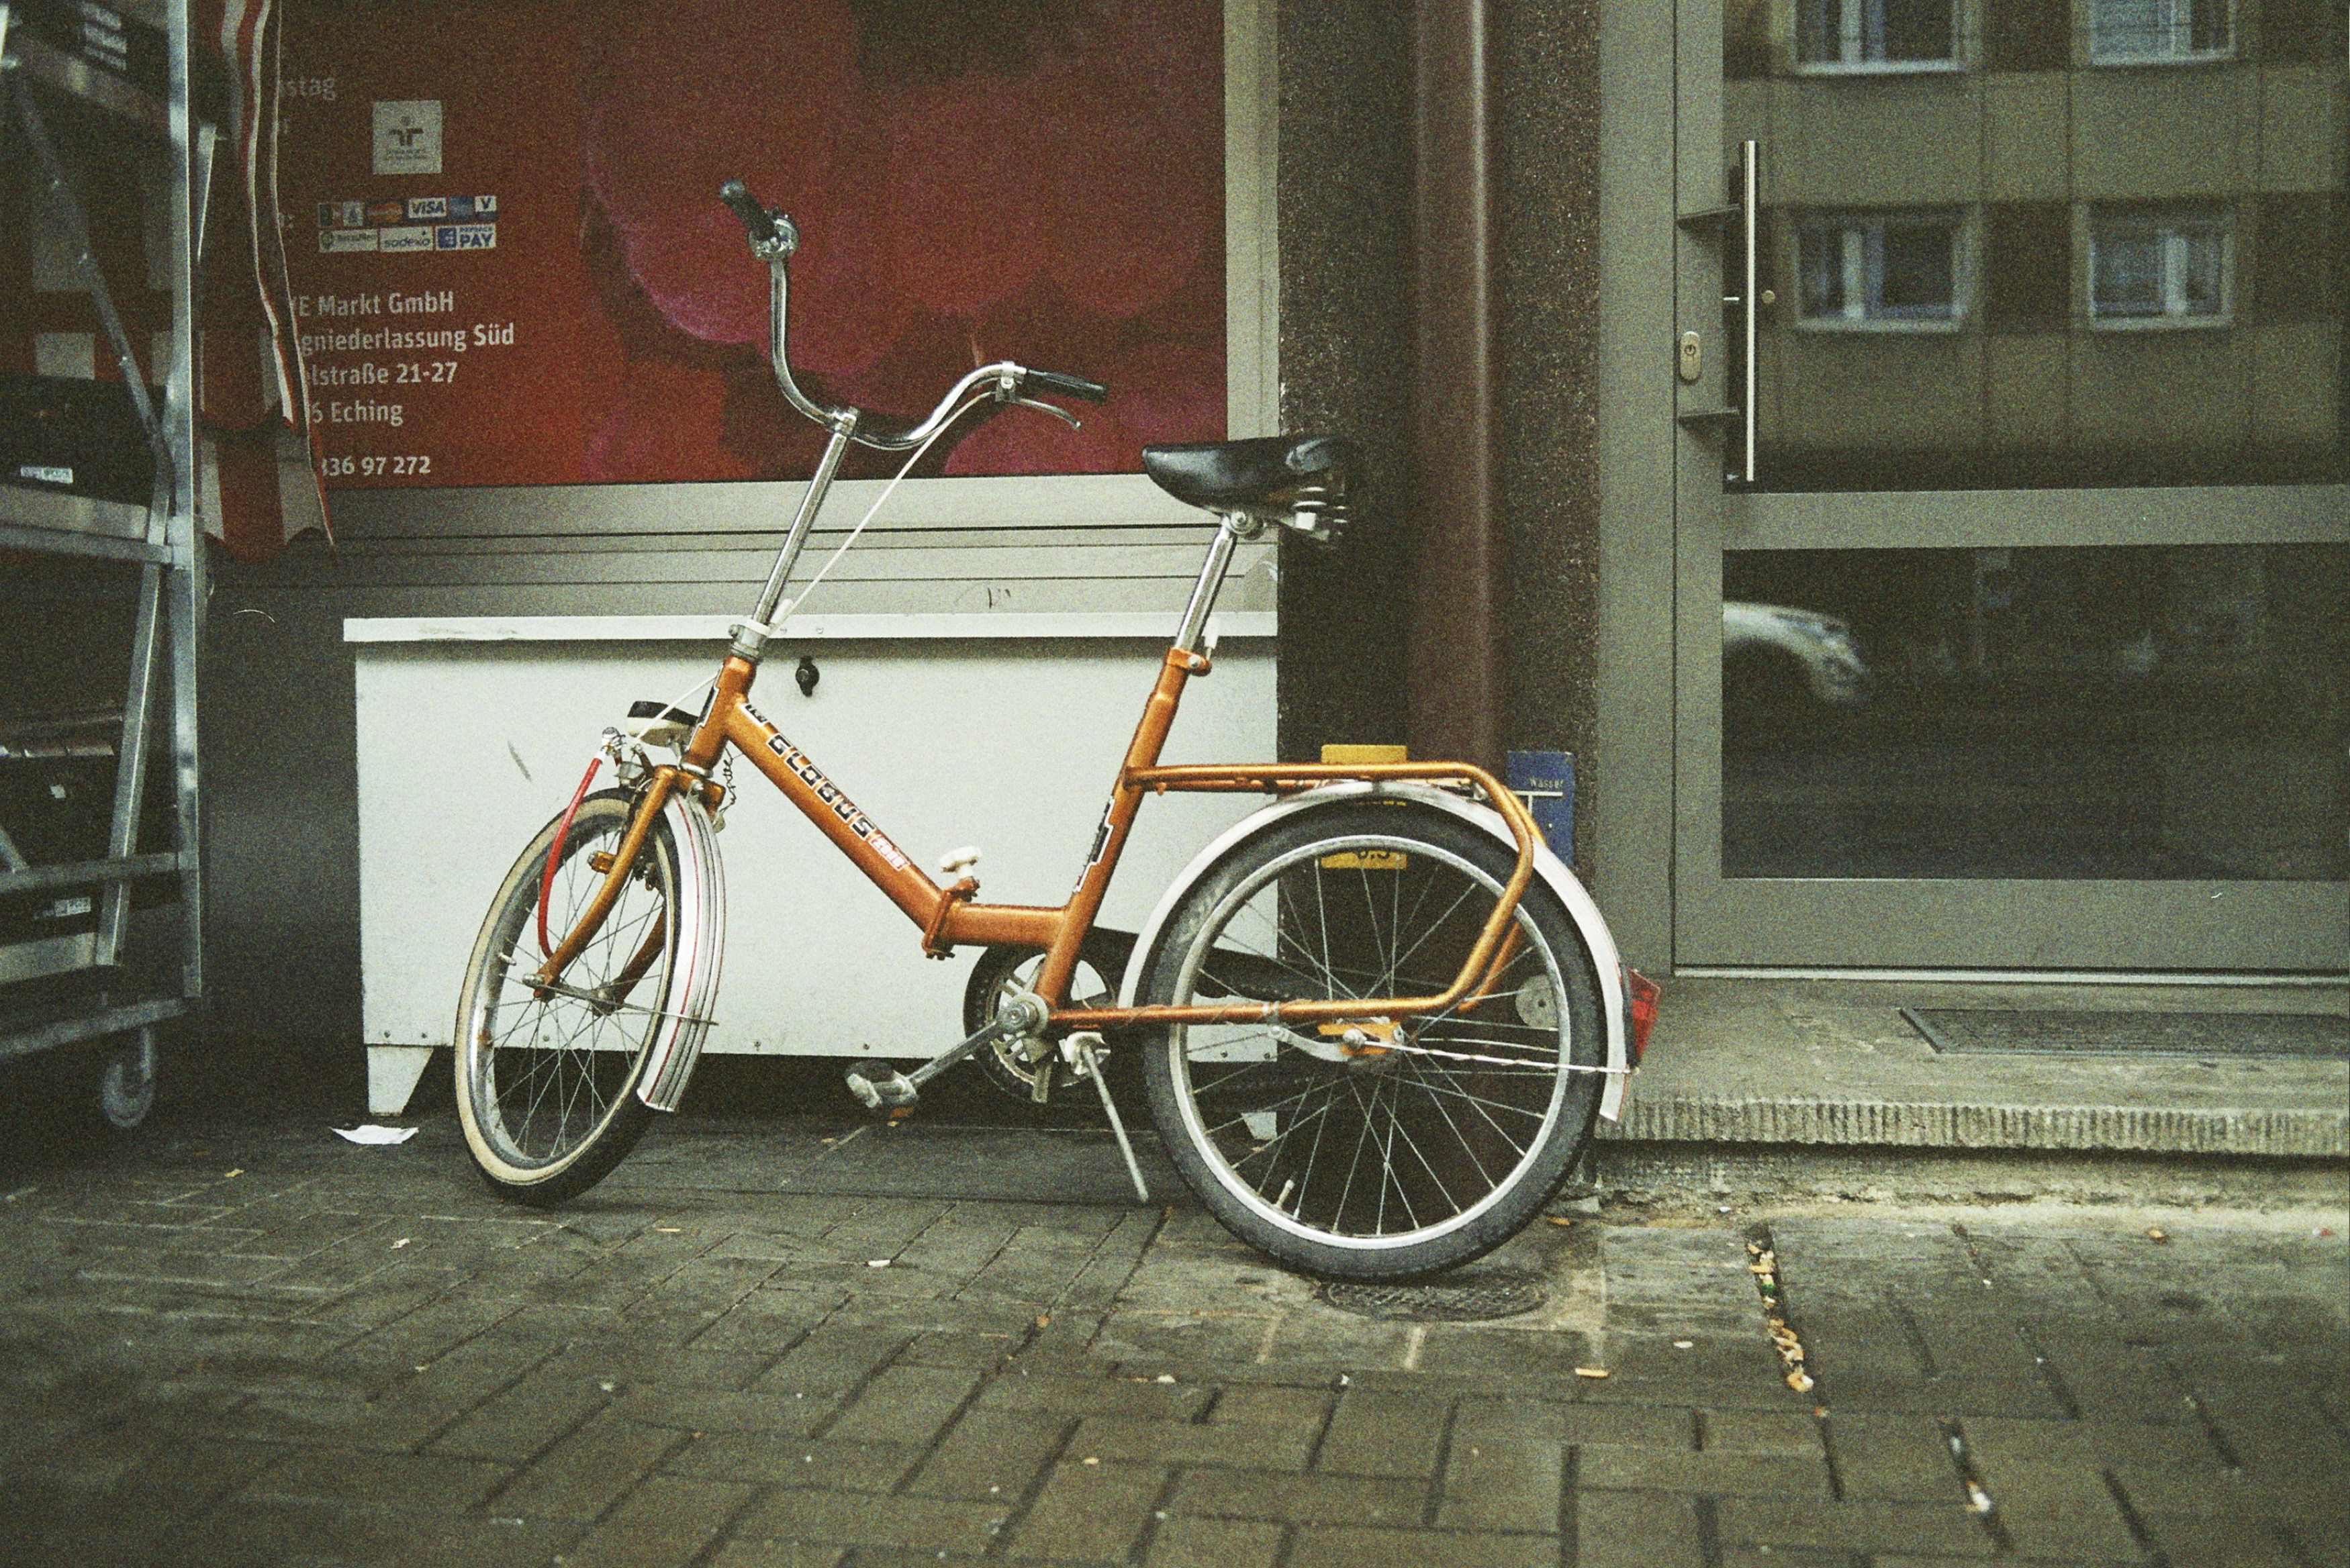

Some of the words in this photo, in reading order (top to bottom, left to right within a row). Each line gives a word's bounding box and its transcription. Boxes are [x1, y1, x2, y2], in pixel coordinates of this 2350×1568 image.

[412, 201, 445, 215] VISA
[460, 233, 493, 248] PAY
[318, 293, 381, 317] Markt
[388, 291, 454, 314] GmbH
[473, 322, 514, 346] Süd
[306, 362, 389, 385] lstraße
[395, 361, 458, 383] 21-27
[331, 399, 404, 427] Eching
[361, 456, 387, 476] 97
[393, 455, 431, 475] 272
[767, 733, 876, 840] GLOBUS
